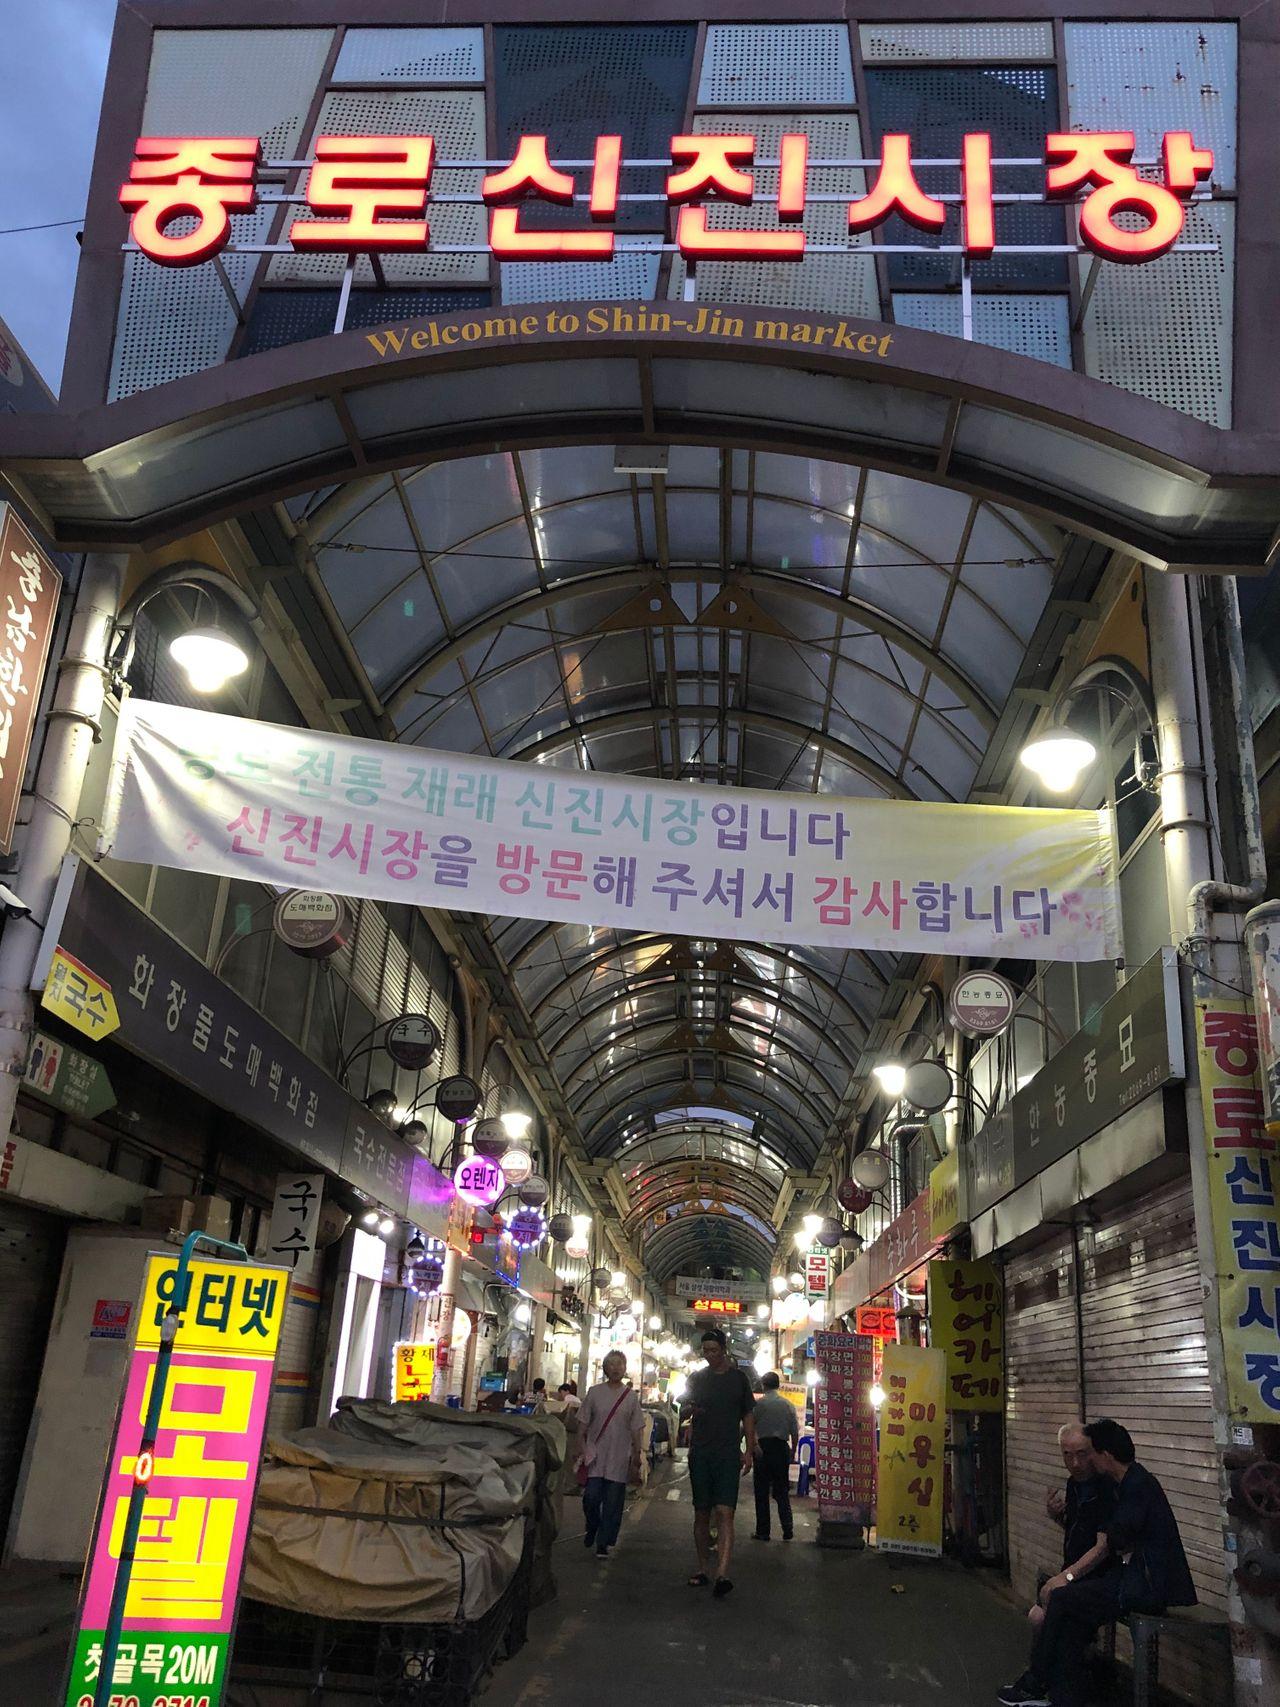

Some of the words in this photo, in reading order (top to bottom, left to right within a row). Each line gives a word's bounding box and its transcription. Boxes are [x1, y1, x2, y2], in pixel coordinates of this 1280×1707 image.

[119, 131, 1213, 266] 종로신진시장
[366, 315, 538, 358] Welcome
[546, 312, 580, 334] to
[586, 306, 743, 338] Shin-Jin
[752, 320, 895, 358] market
[291, 747, 388, 807] 전통
[401, 766, 495, 825] 재래
[514, 779, 851, 860] 신진시장입니다
[225, 805, 478, 889] 신진시장을
[495, 841, 636, 909] 방문해
[651, 861, 794, 924] 주셔서
[812, 876, 1058, 936] 감사합니다
[64, 970, 109, 1029] 국수
[458, 1166, 500, 1192] 오렌지
[272, 1180, 317, 1267] 국수
[808, 1256, 828, 1291] 모텔
[155, 1269, 277, 1337] 인터넷
[694, 1299, 740, 1312] 성폭력
[818, 1403, 853, 1418] 냉면
[818, 1430, 853, 1446] 돈까스
[108, 1363, 257, 1620] 모텔
[819, 1472, 855, 1489] 양장피
